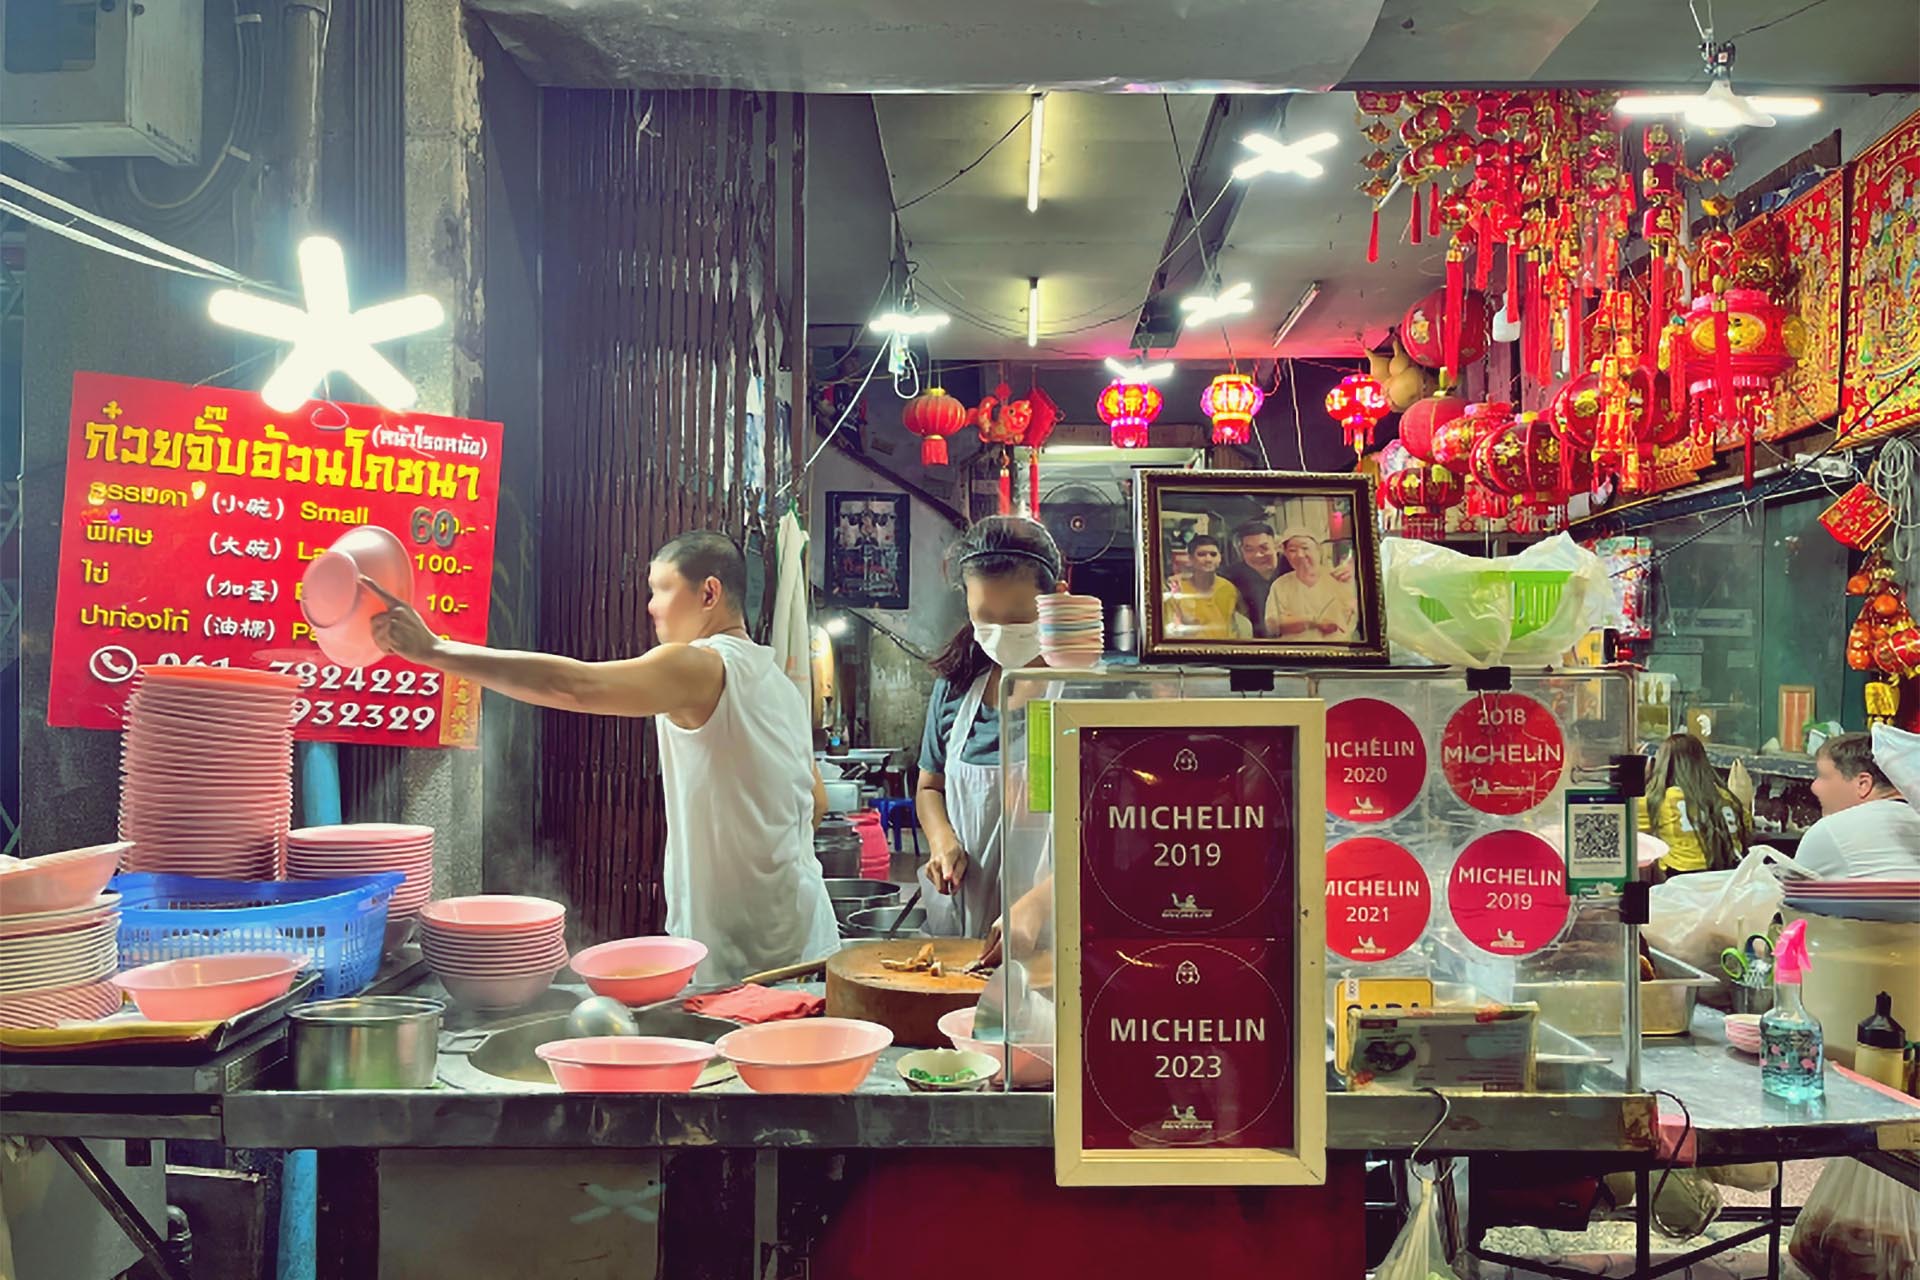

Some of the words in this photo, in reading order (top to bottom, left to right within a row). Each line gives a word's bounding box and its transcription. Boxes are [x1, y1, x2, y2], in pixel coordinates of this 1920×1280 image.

[300, 501, 369, 524] Small
[86, 520, 154, 546] พิเศษ
[291, 697, 436, 731] 932329
[1478, 708, 1527, 726] 2018
[1444, 744, 1561, 764] MICHELIN
[1343, 766, 1388, 784] 2020
[1108, 806, 1265, 829] MICHELIN
[1153, 843, 1222, 867] 2019
[1458, 866, 1562, 887] MICHELIN
[1485, 893, 1533, 911] 2019
[1345, 906, 1390, 923] 2021
[1110, 1018, 1266, 1042] MICHELIN
[1154, 1055, 1223, 1079] 2023
